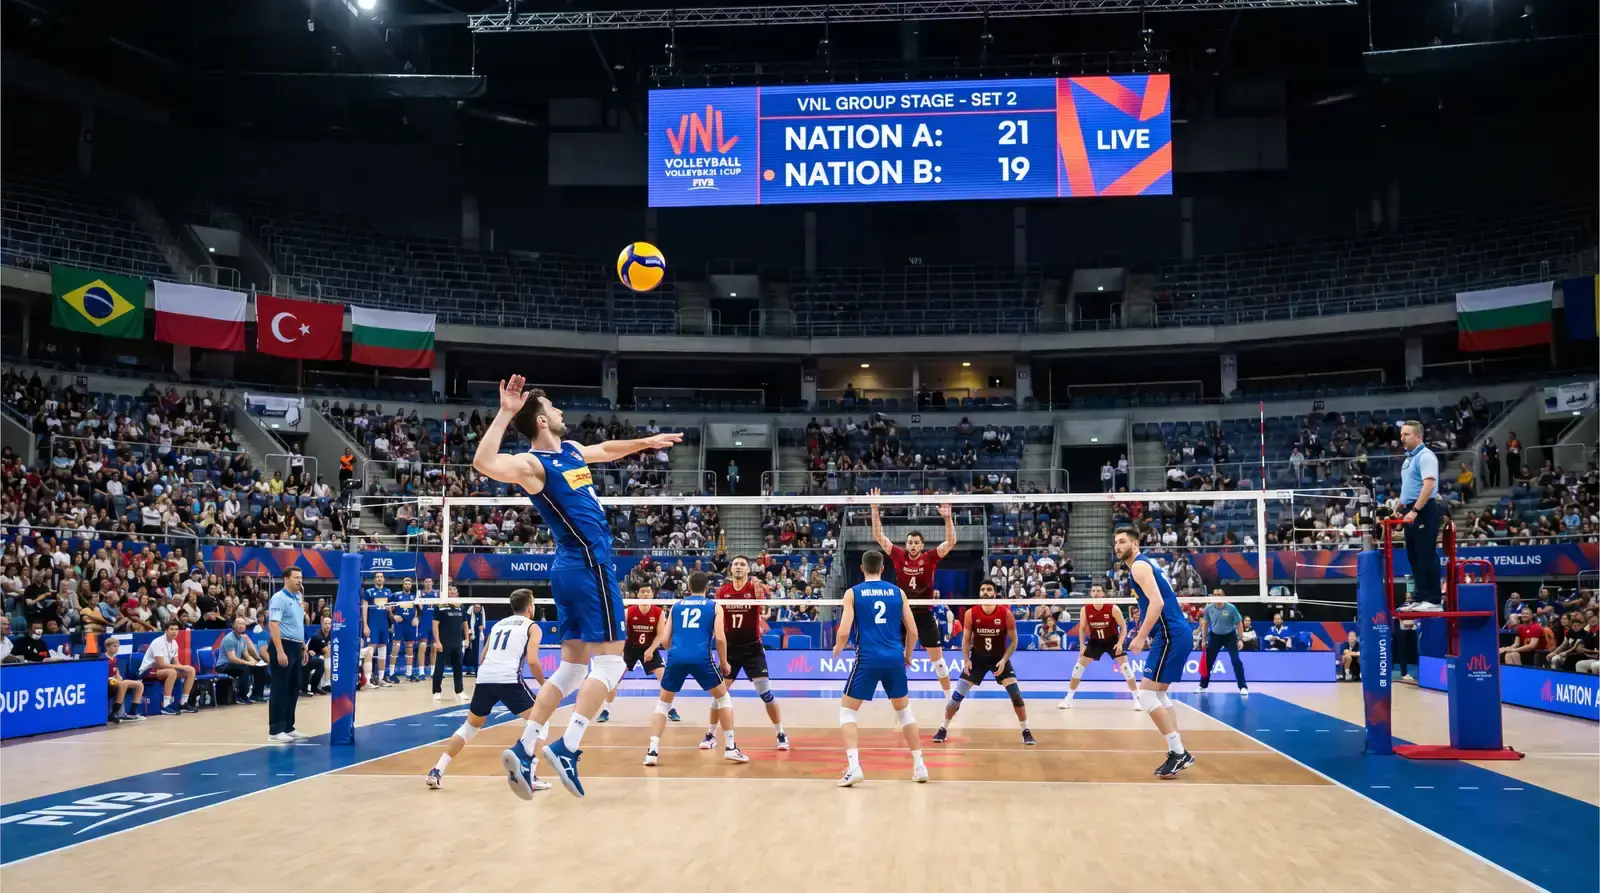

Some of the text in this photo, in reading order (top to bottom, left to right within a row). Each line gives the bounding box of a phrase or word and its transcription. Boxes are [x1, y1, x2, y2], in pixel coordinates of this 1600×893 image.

[797, 97, 831, 111] VNL
[836, 95, 896, 110] GROUP
[901, 93, 954, 108] STAGE
[971, 92, 1002, 107] SET
[1007, 91, 1017, 106] 2
[666, 104, 739, 155] VNL
[785, 123, 943, 151] NATION A:
[998, 119, 1029, 145] 21
[1097, 128, 1150, 150] LIVE
[664, 157, 741, 168] VOLLEYBALL
[785, 158, 942, 187] NATION B:
[998, 156, 1030, 182] 19
[511, 562, 548, 571] NATION
[908, 576, 917, 590] 4
[680, 607, 702, 629] 12
[731, 613, 743, 629] 17
[873, 600, 887, 624] 2
[493, 629, 512, 651] 11
[1096, 629, 1105, 639] 11
[35, 683, 86, 710] STAGE
[1556, 683, 1592, 707] NATION
